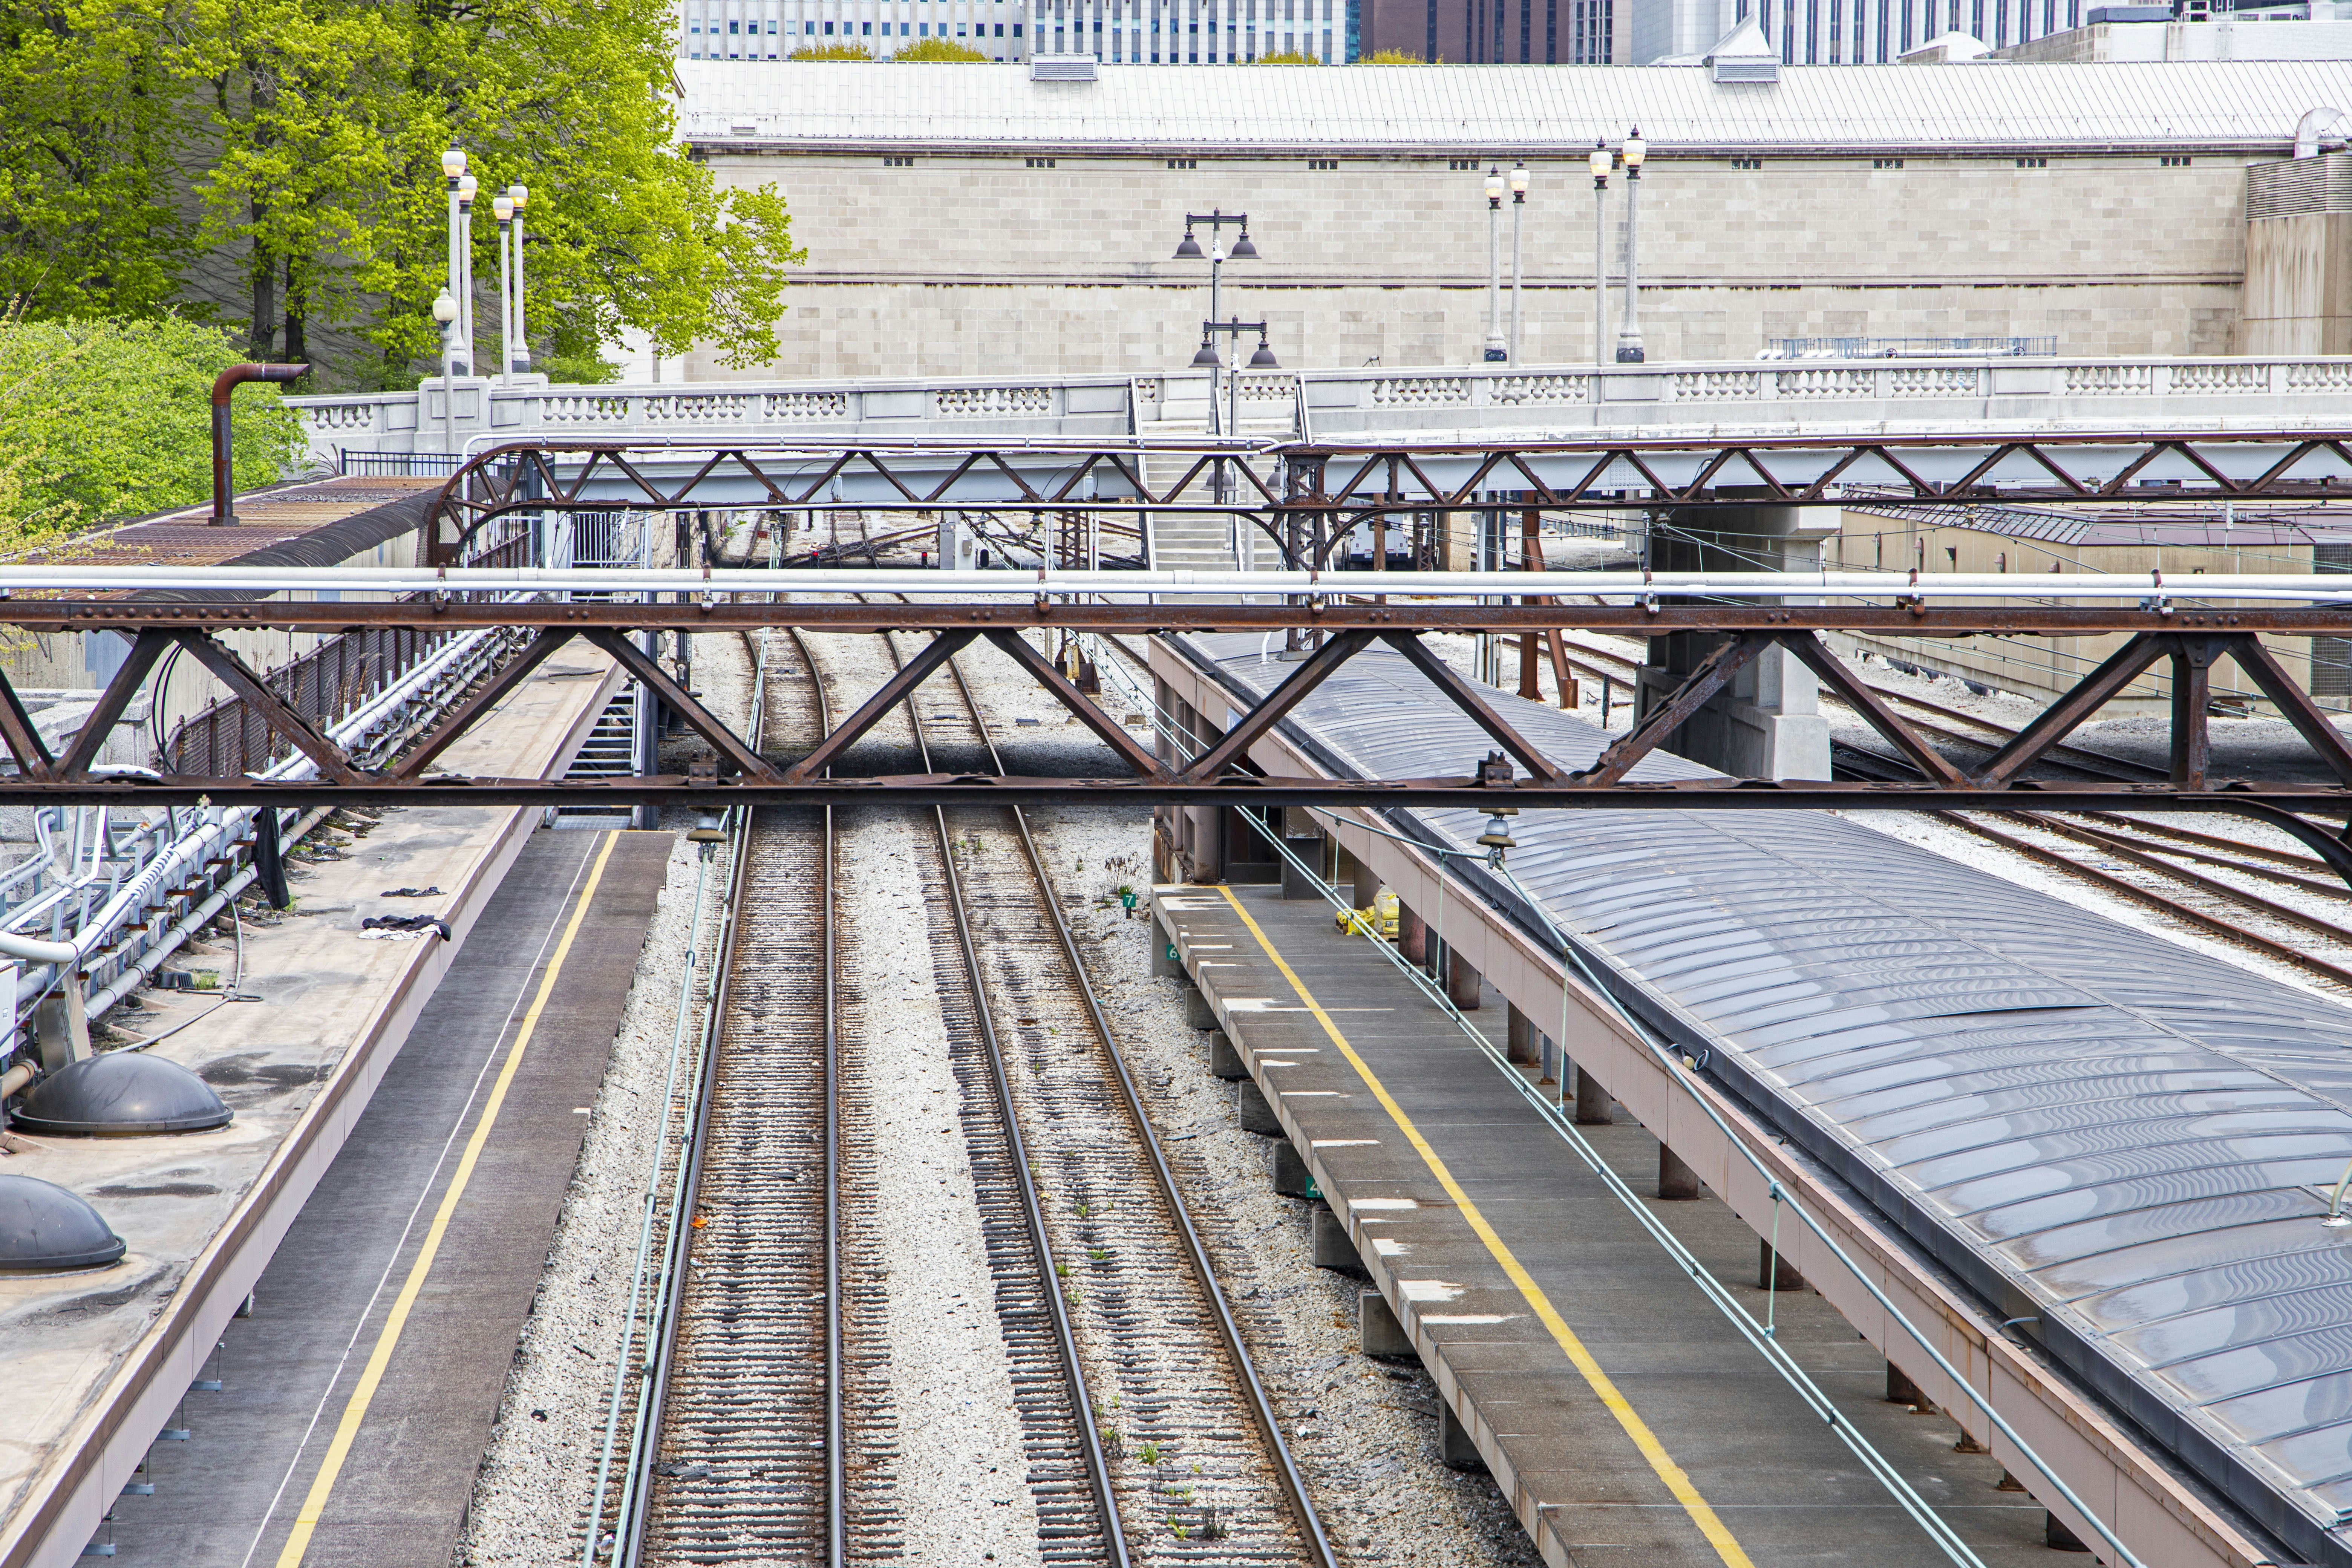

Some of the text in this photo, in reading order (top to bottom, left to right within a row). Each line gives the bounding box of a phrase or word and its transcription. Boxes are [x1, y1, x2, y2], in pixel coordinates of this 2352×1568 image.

[1126, 895, 1133, 905] 7
[1170, 947, 1178, 958] 6
[1310, 1182, 1320, 1195] 4
